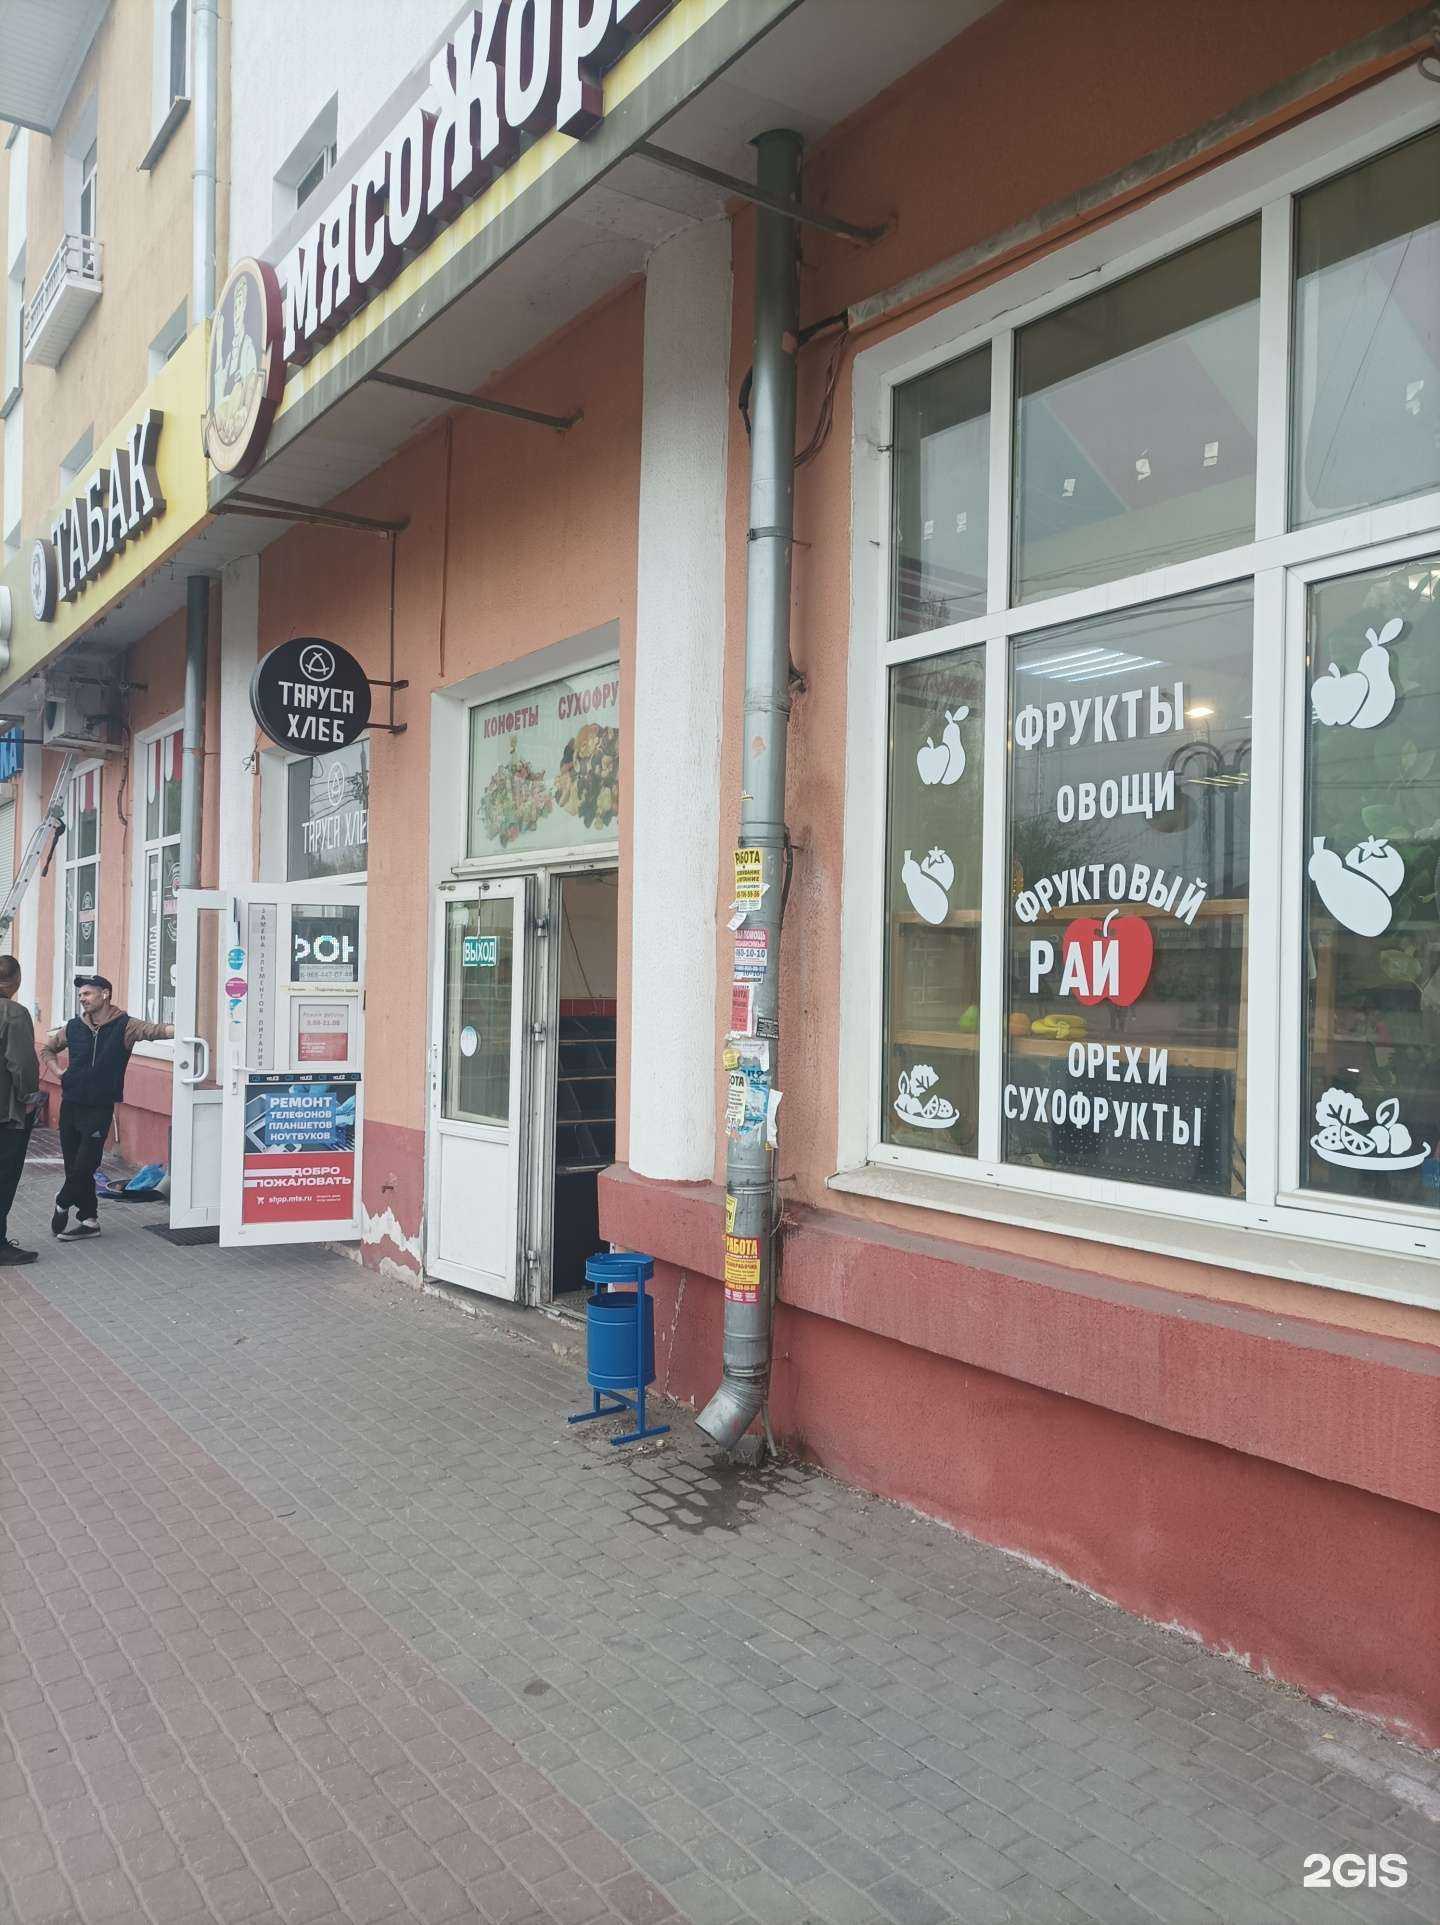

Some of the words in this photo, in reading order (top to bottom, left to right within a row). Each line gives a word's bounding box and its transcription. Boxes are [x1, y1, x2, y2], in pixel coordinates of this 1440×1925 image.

[278, 0, 643, 361] МЯСОЖОР
[51, 409, 160, 601] ТАБАК
[278, 681, 354, 714] ТАРУСА
[287, 713, 345, 744] ХЛЕБ
[483, 705, 539, 739] КОНФЕТЫ
[1015, 682, 1185, 750] ФРУКТЫ
[1056, 770, 1175, 823] ОВОЩИ
[302, 816, 340, 854] ТАРУСА
[345, 809, 370, 847] ХЛЕ
[1015, 863, 1208, 926] ФРУКТОВЫЙ
[465, 941, 496, 962] ВЫХОД
[1068, 1042, 1169, 1086] ОРЕХИ
[269, 1096, 333, 1109] РЕМОНТ
[269, 1110, 333, 1120] ТЕЛЕФОНОВ
[1003, 1083, 1202, 1147] СУХОФРУКТЫ
[268, 1121, 333, 1131] ПЛАНШЕТОВ
[270, 1132, 331, 1141] НОУТБУКОВ
[255, 1176, 352, 1188] ПОЖАЛОВАТЬ
[291, 1166, 341, 1178] ДОБРО
